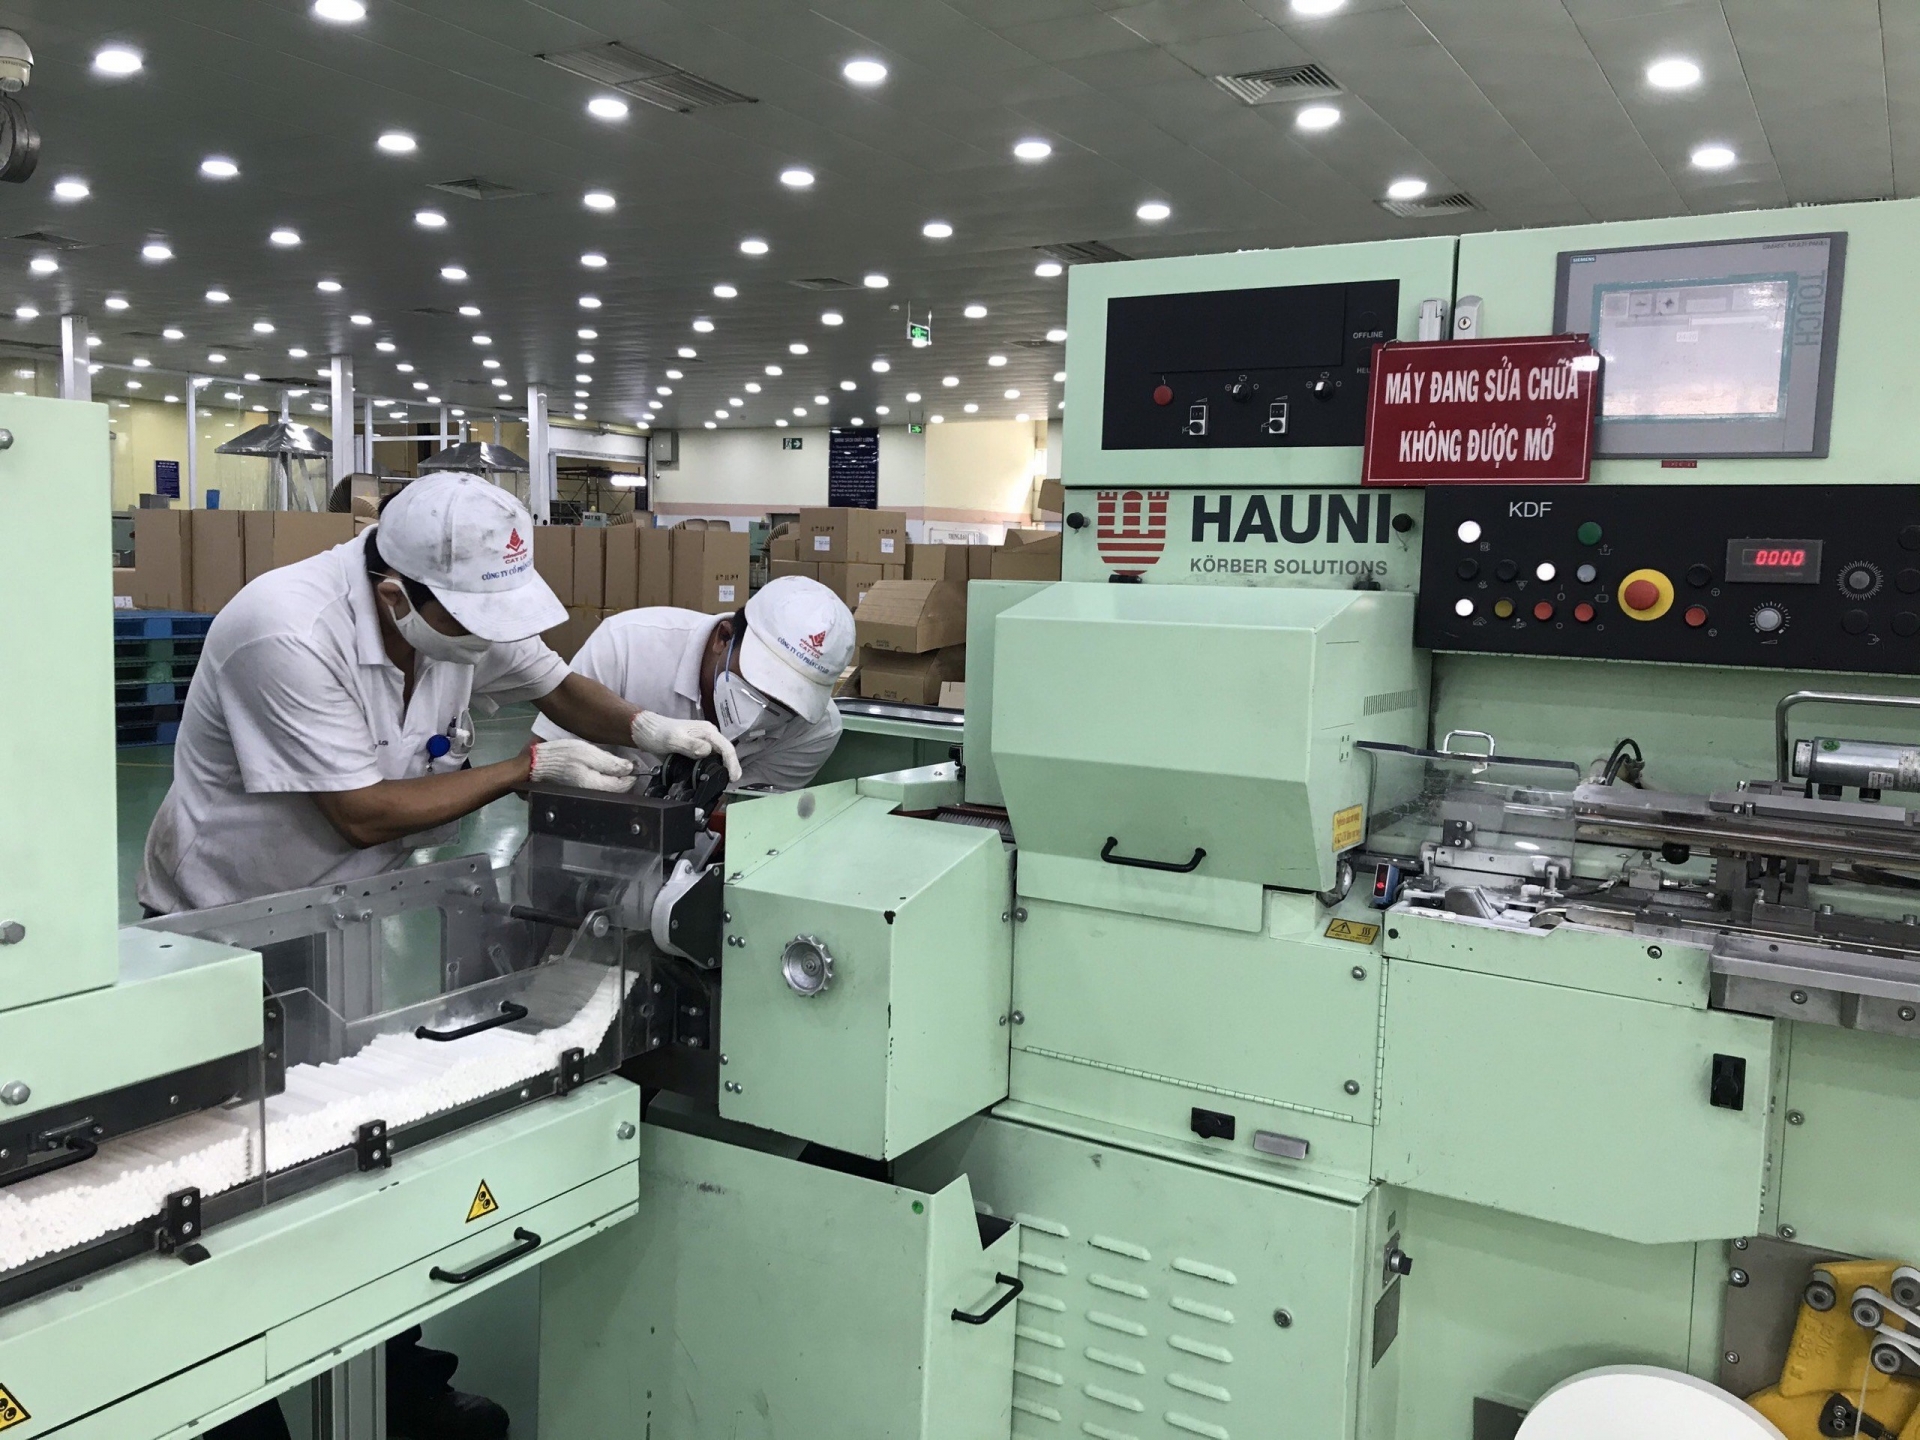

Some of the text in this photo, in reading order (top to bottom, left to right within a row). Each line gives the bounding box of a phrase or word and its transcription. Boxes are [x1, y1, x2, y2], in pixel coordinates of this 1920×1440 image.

[1795, 269, 1826, 346] TOUCH
[1352, 331, 1384, 339] OFFLINE
[1384, 356, 1579, 405] MÁY ĐANG SỬA CHỮA
[1399, 414, 1557, 469] KHÔNG ĐƯỢC MỞ
[1191, 494, 1392, 543] HAUNI
[1509, 501, 1553, 518] KDF
[1190, 555, 1388, 576] KÖRBER SOLUTIONS
[1755, 550, 1805, 566] 0000
[481, 571, 499, 580] CÔNG
[509, 565, 517, 575] CỔ
[777, 637, 790, 649] CÔNG
[790, 646, 797, 654] TY
[796, 651, 805, 659] CỔ
[799, 643, 811, 653] CAT
